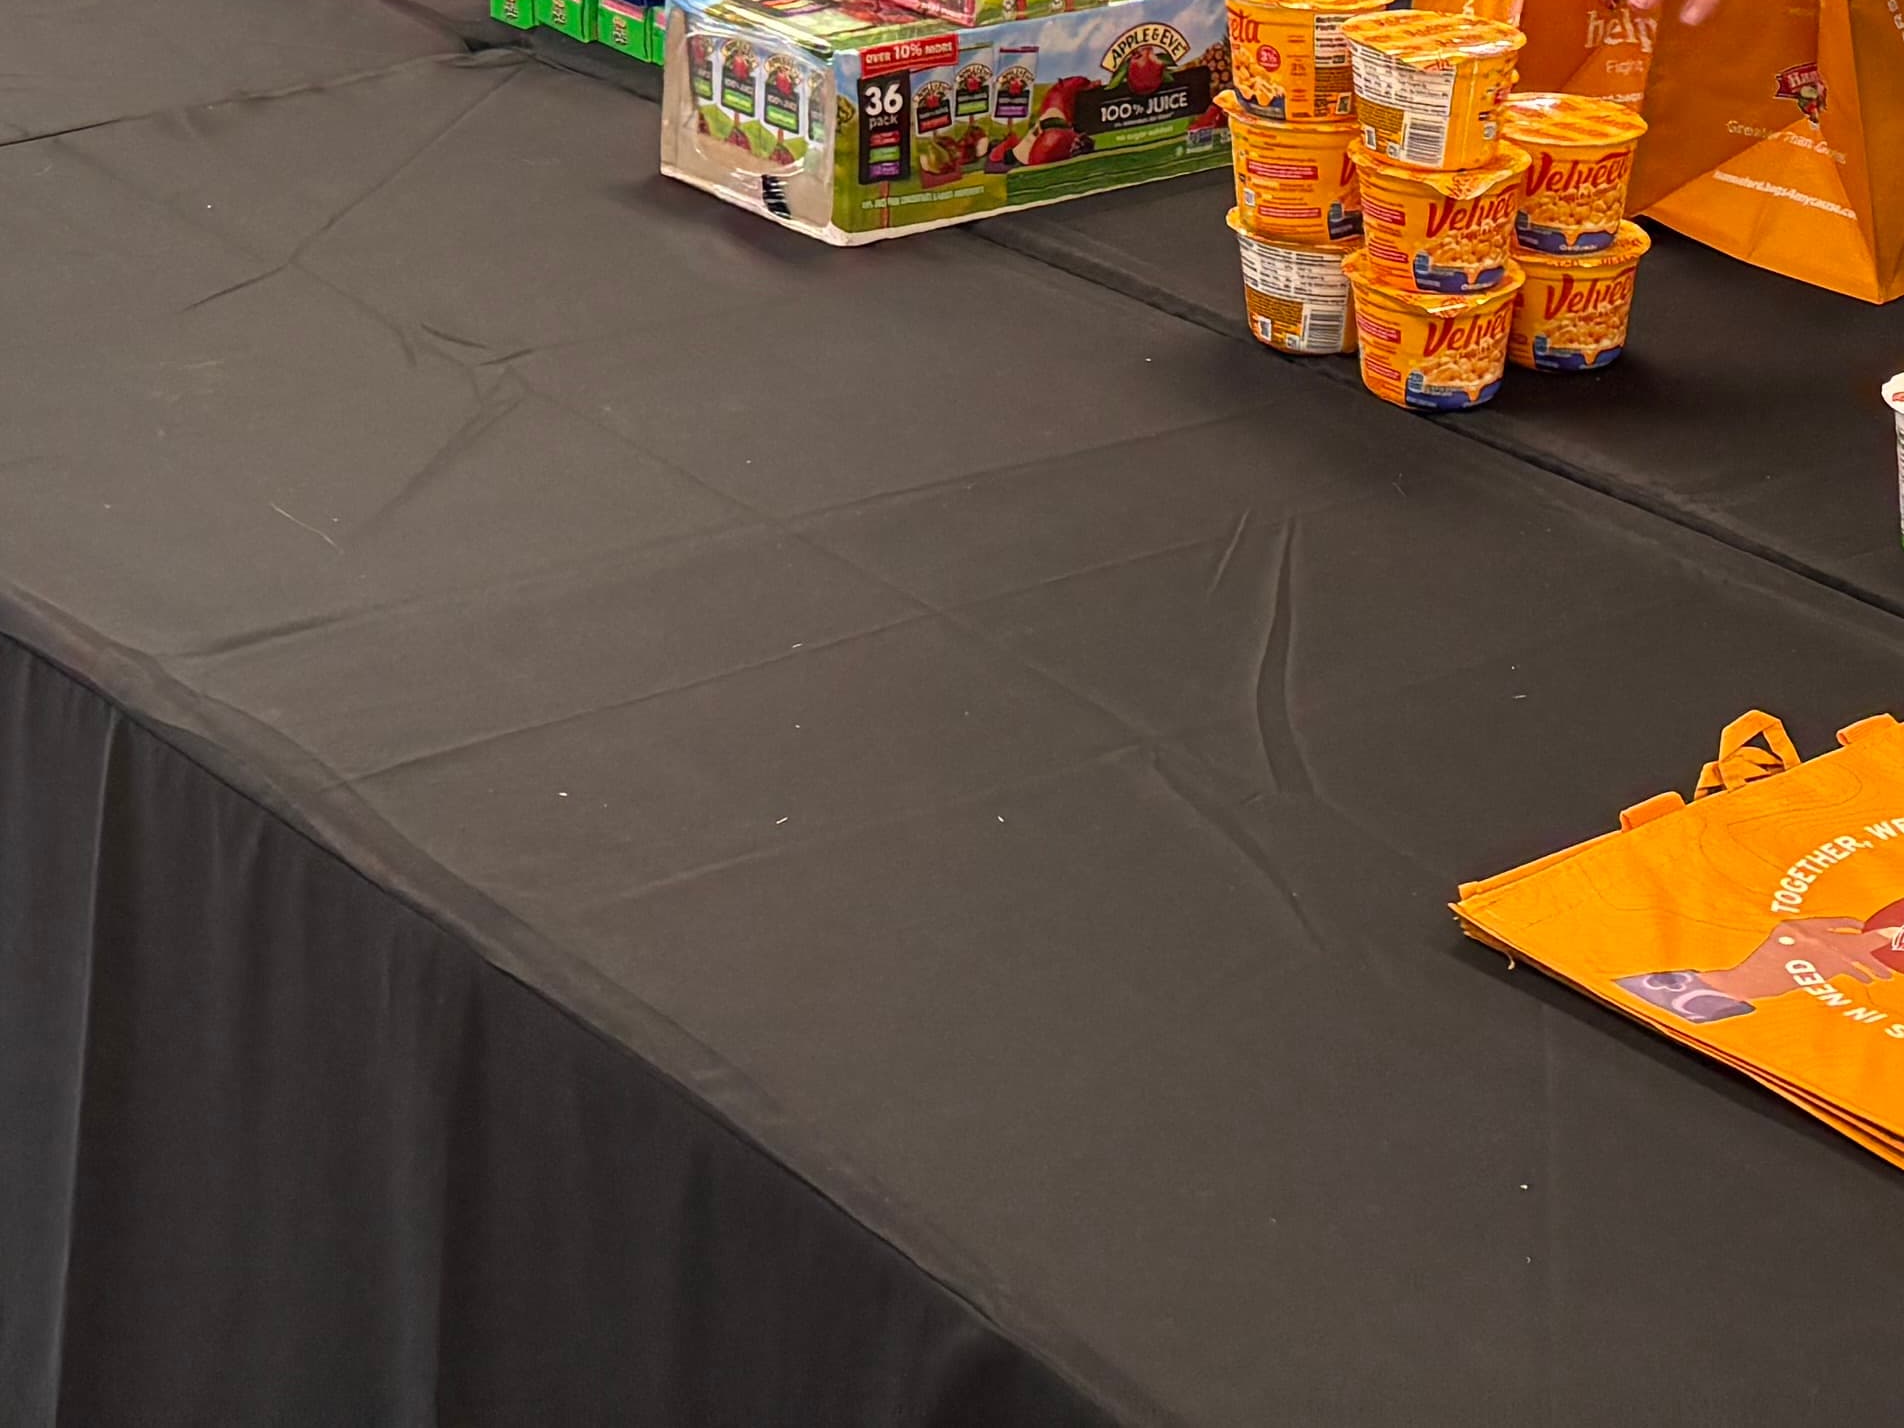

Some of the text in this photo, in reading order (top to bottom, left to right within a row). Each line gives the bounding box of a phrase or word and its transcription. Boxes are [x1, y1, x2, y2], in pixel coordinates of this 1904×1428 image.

[1228, 9, 1261, 44] eta
[1583, 10, 1658, 55] help
[865, 40, 953, 65] OVER 10% MORE
[864, 83, 904, 117] 36
[1100, 92, 1189, 123] 100% JUICE
[868, 113, 900, 130] pack
[1770, 835, 1875, 915] TOGETHER,
[1784, 959, 1853, 1010] NEED
[1845, 1004, 1889, 1025] IN
